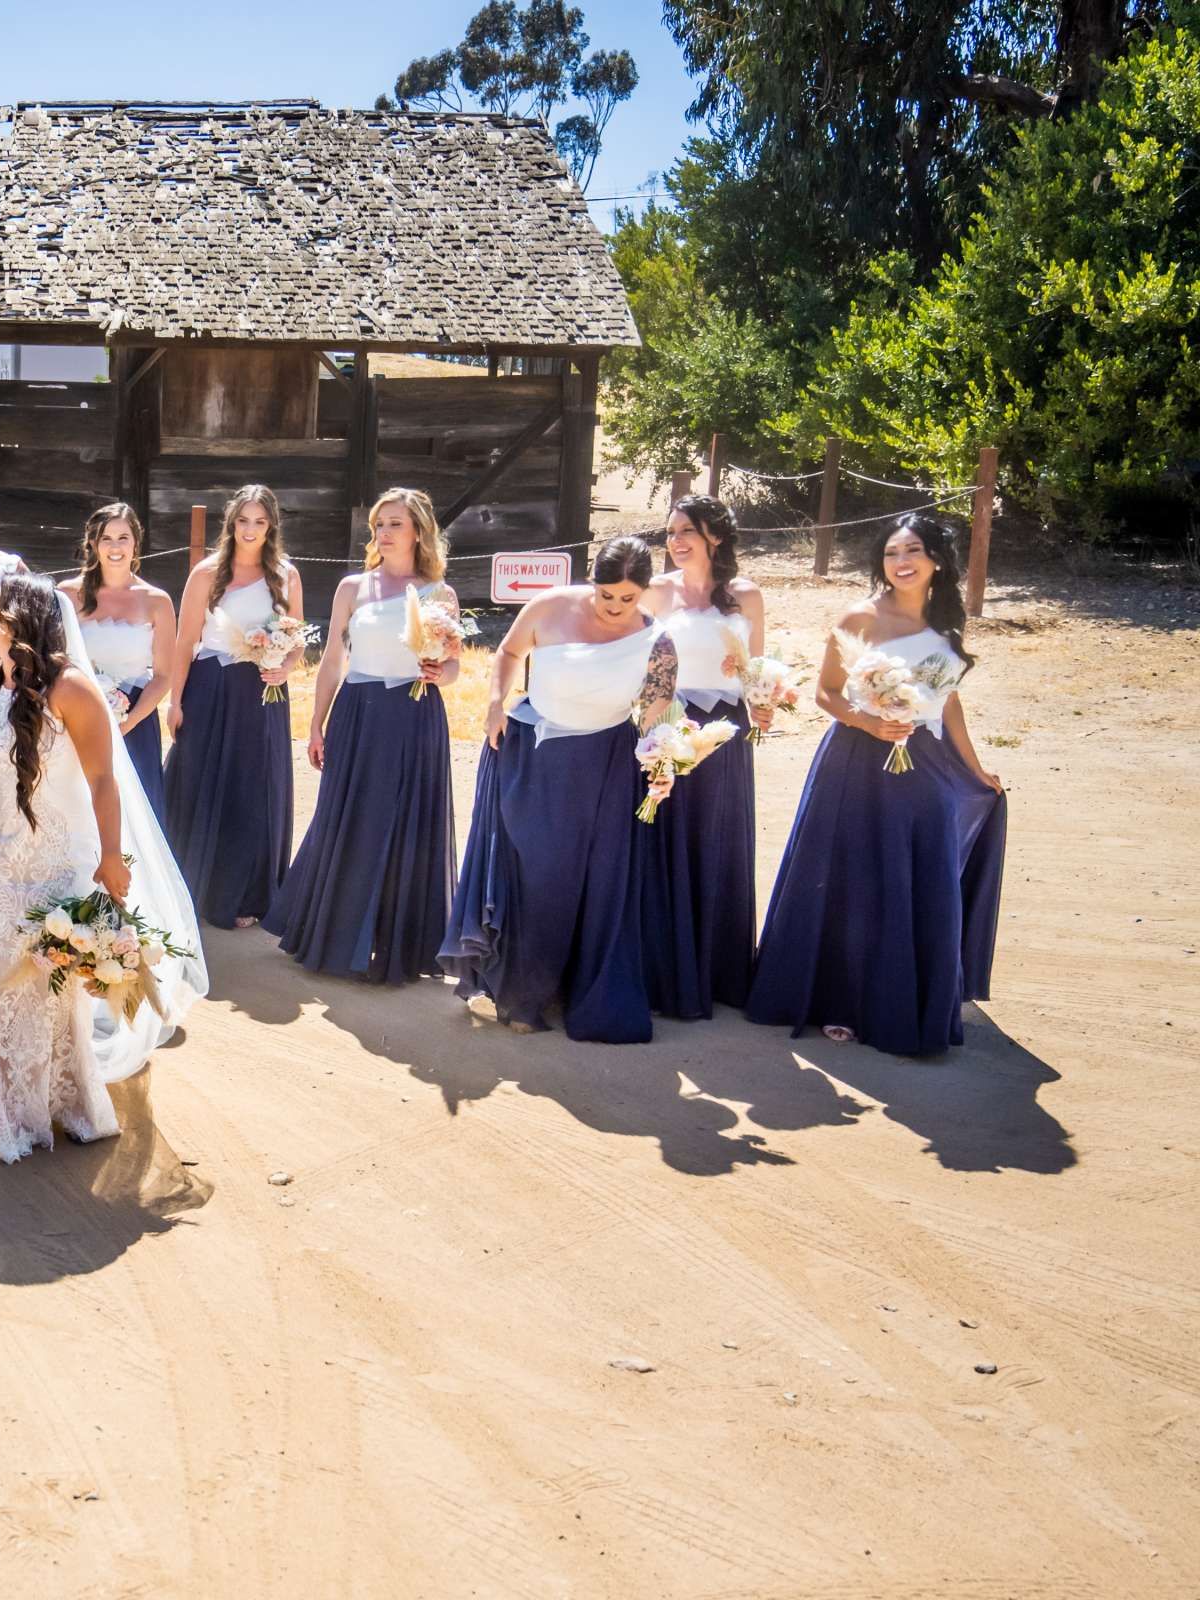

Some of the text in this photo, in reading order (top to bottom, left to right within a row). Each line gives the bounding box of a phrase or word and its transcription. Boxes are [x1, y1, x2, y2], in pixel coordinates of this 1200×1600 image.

[498, 564, 560, 576] THIS WAY OUT
